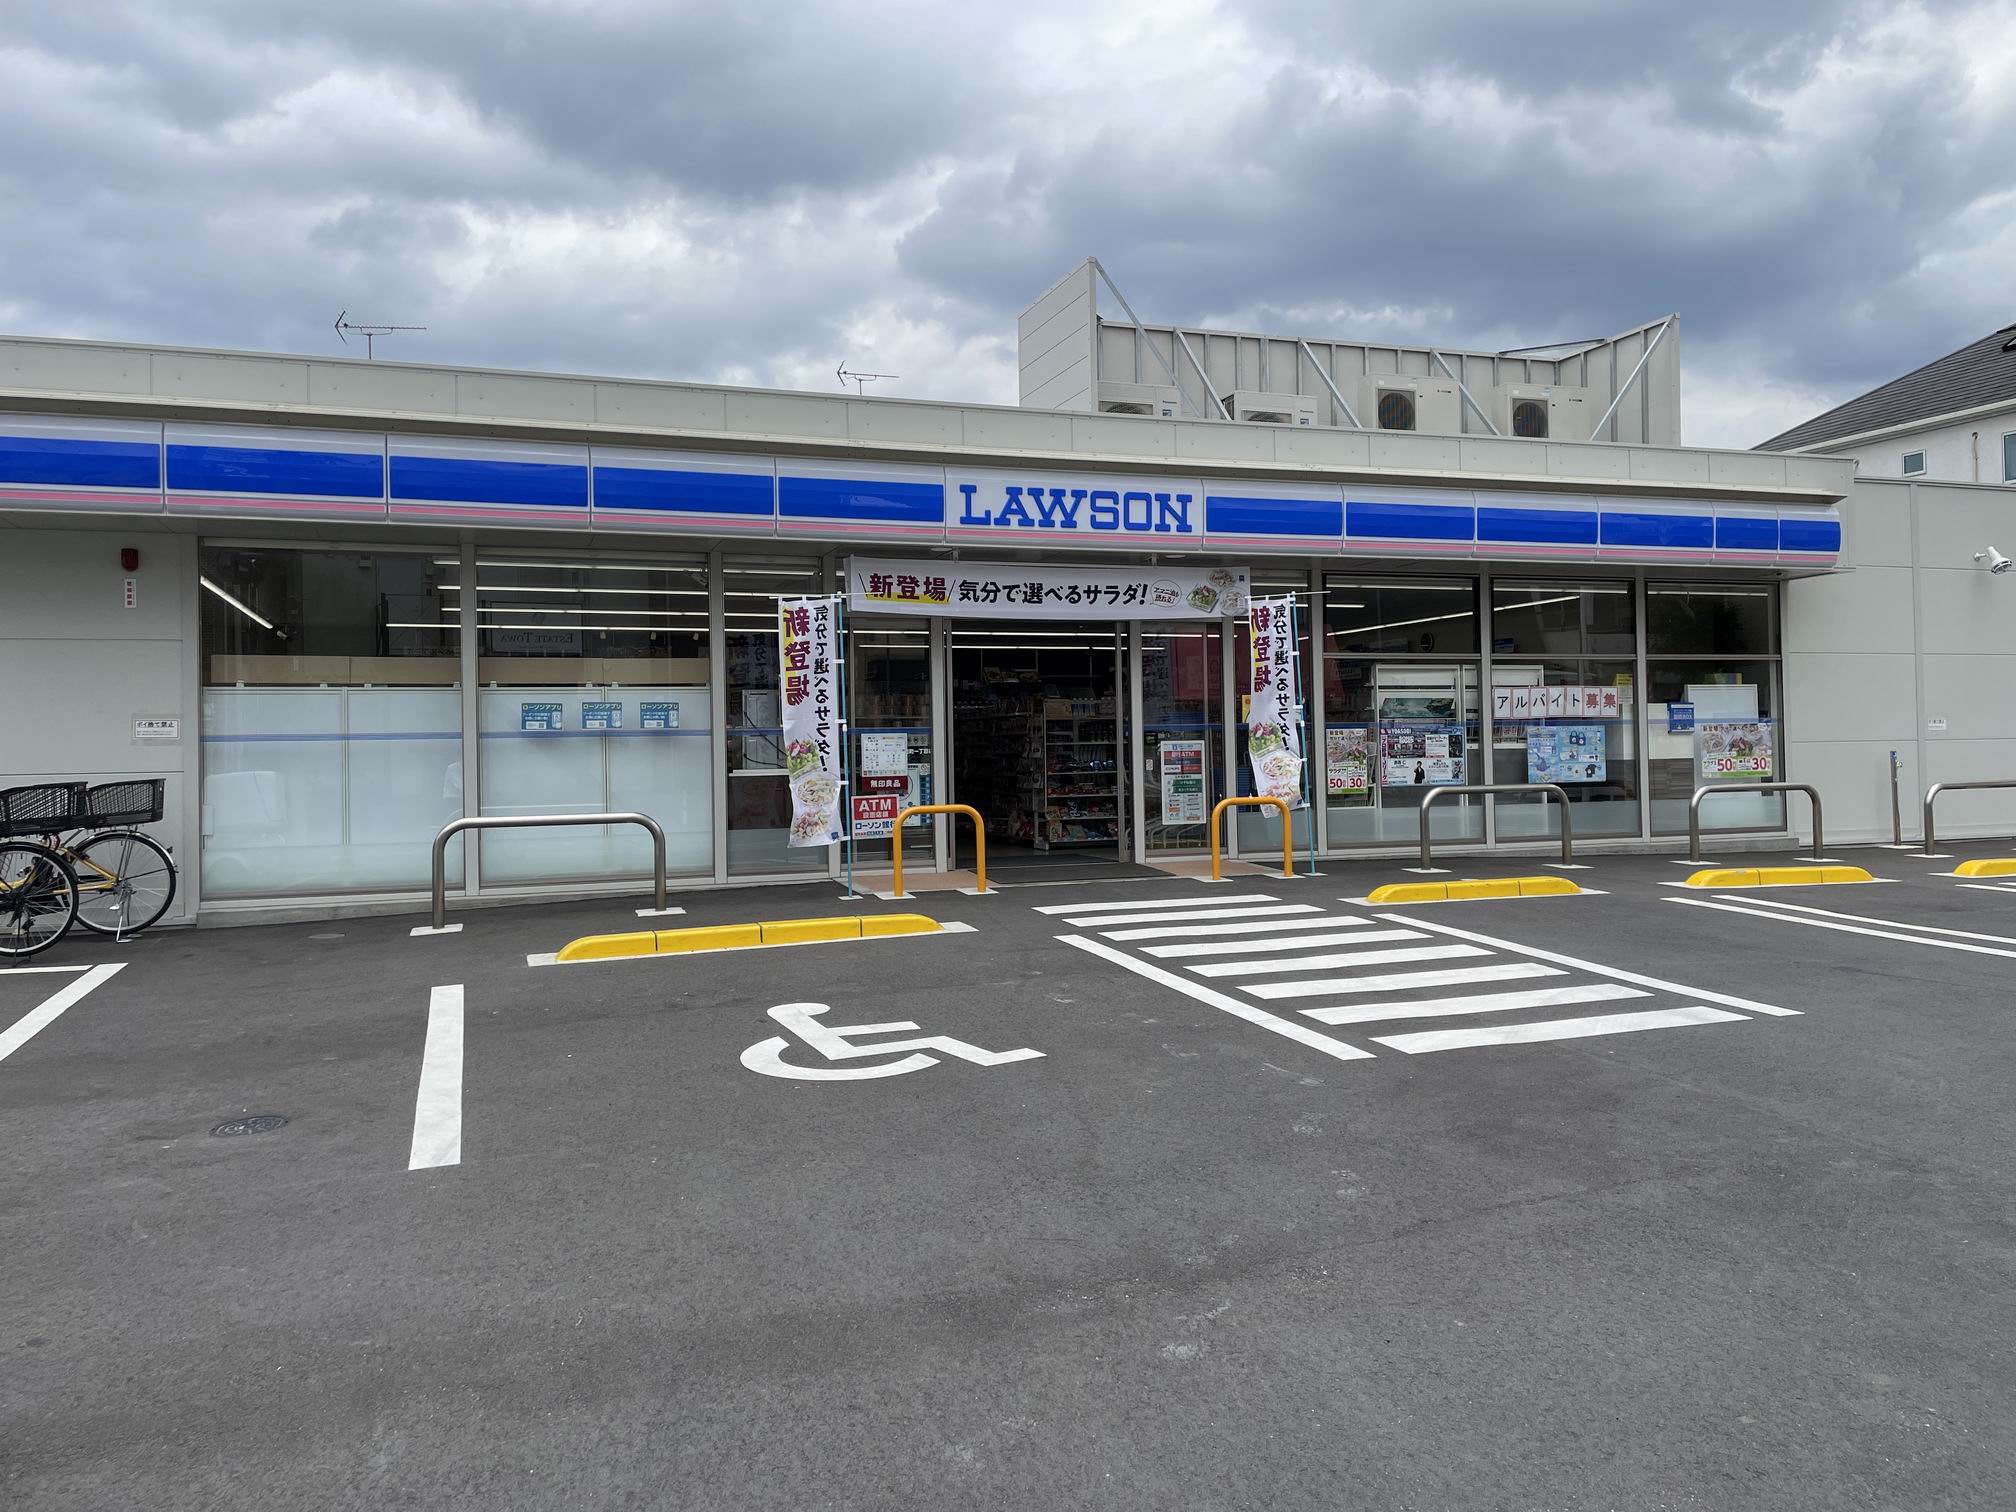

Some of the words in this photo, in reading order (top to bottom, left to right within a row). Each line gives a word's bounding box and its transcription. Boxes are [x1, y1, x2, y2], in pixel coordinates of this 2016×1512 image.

[959, 484, 1192, 532] LAWSON
[868, 572, 947, 603] 新登場
[958, 578, 1148, 606] 気分で選べるサラダ!
[1496, 693, 1617, 709] アルバイト募集
[1717, 758, 1733, 772] 50
[1751, 757, 1767, 771] 30
[870, 779, 901, 788] 無印良品
[1329, 778, 1343, 789] 50
[1349, 778, 1362, 788] 30
[858, 798, 892, 812] ATM
